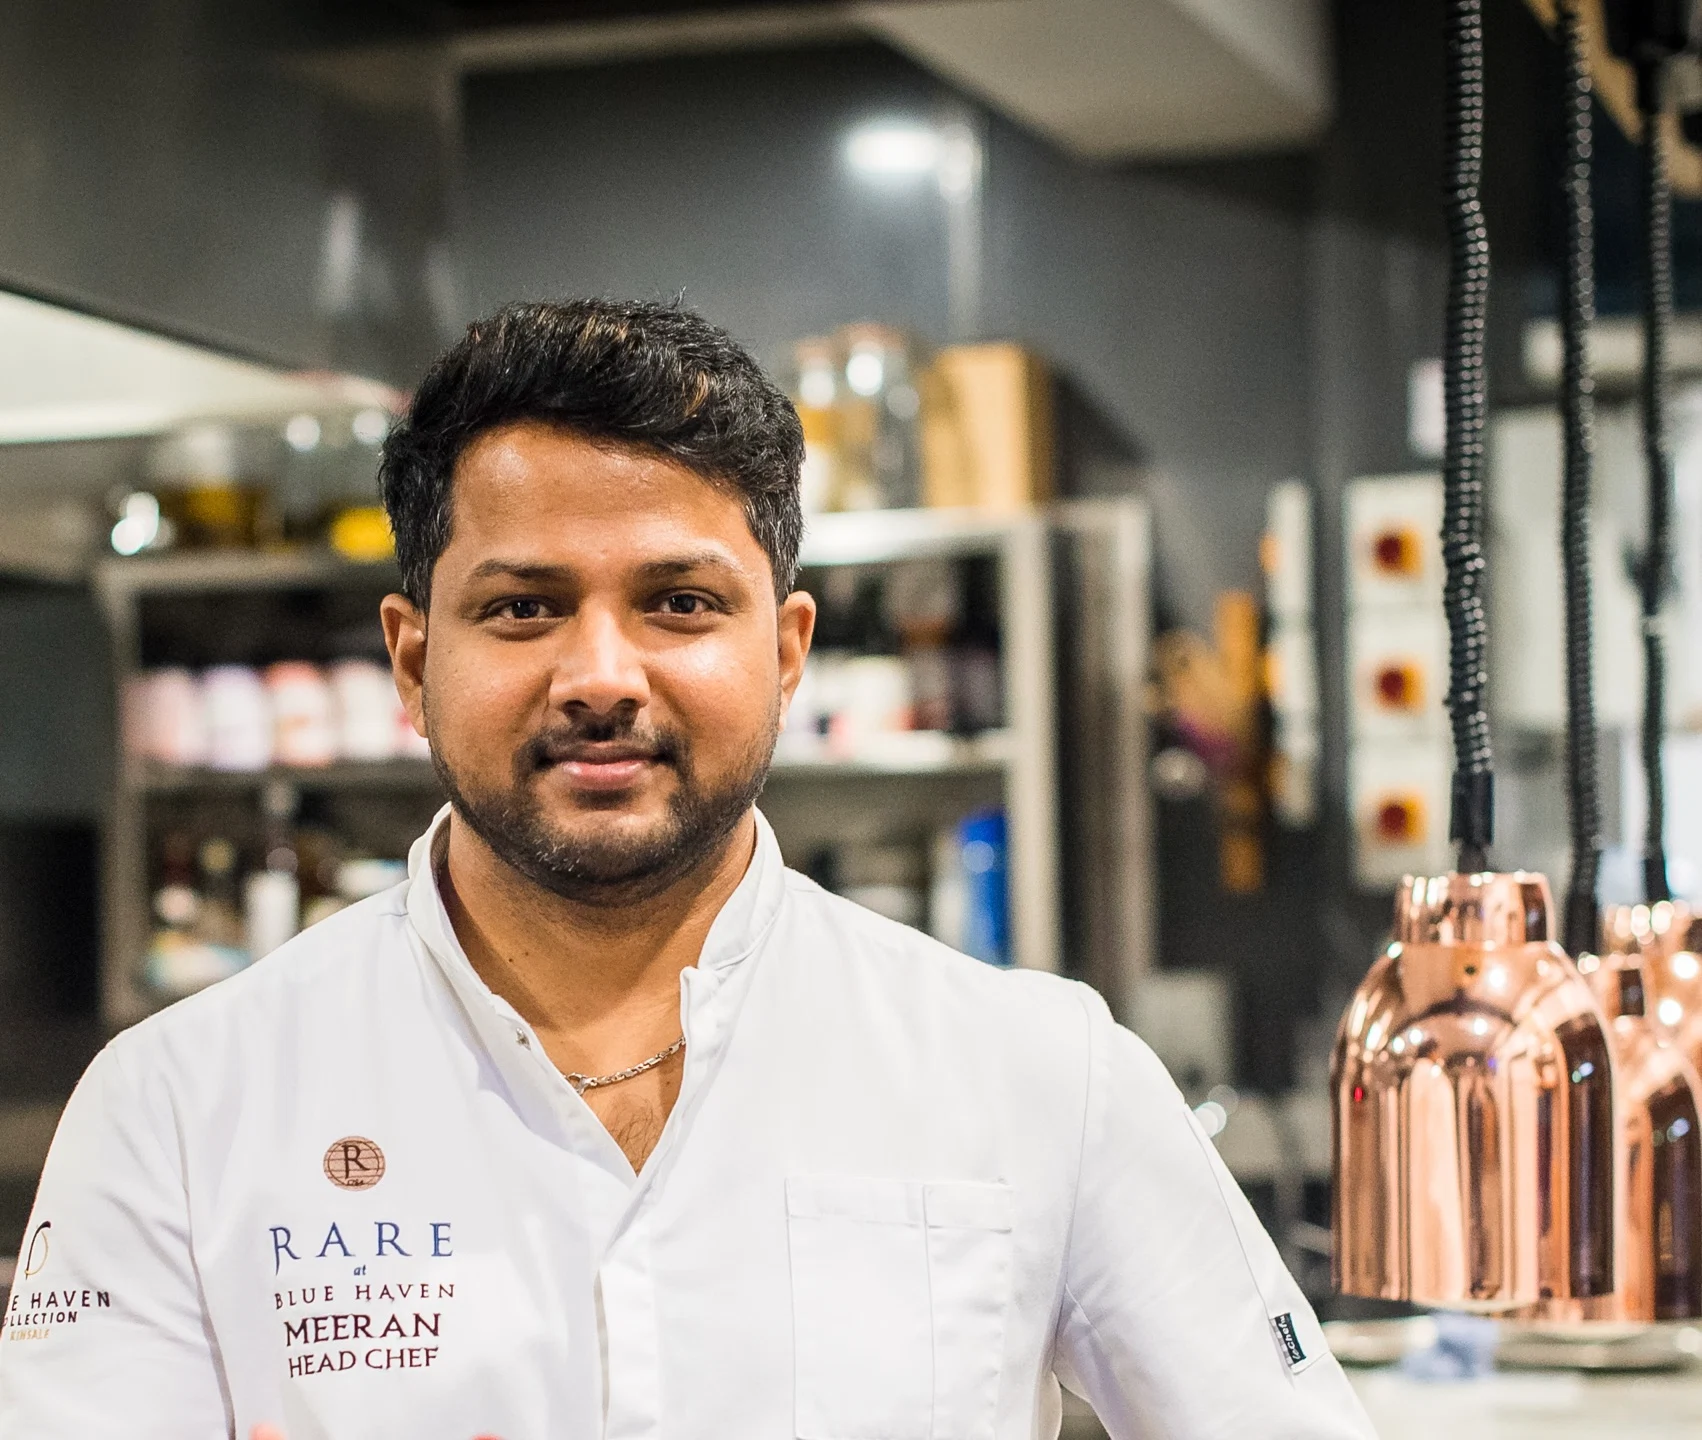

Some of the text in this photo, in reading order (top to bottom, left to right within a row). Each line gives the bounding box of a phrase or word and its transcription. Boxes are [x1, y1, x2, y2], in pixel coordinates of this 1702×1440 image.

[268, 1221, 453, 1276] RARE
[353, 1264, 367, 1277] at
[30, 1290, 111, 1309] HAVEN
[274, 1282, 455, 1310] BLUE HAVEN
[10, 1328, 51, 1341] KINSALE
[283, 1312, 441, 1347] MEERAN
[288, 1346, 440, 1378] HEAD CHEF
